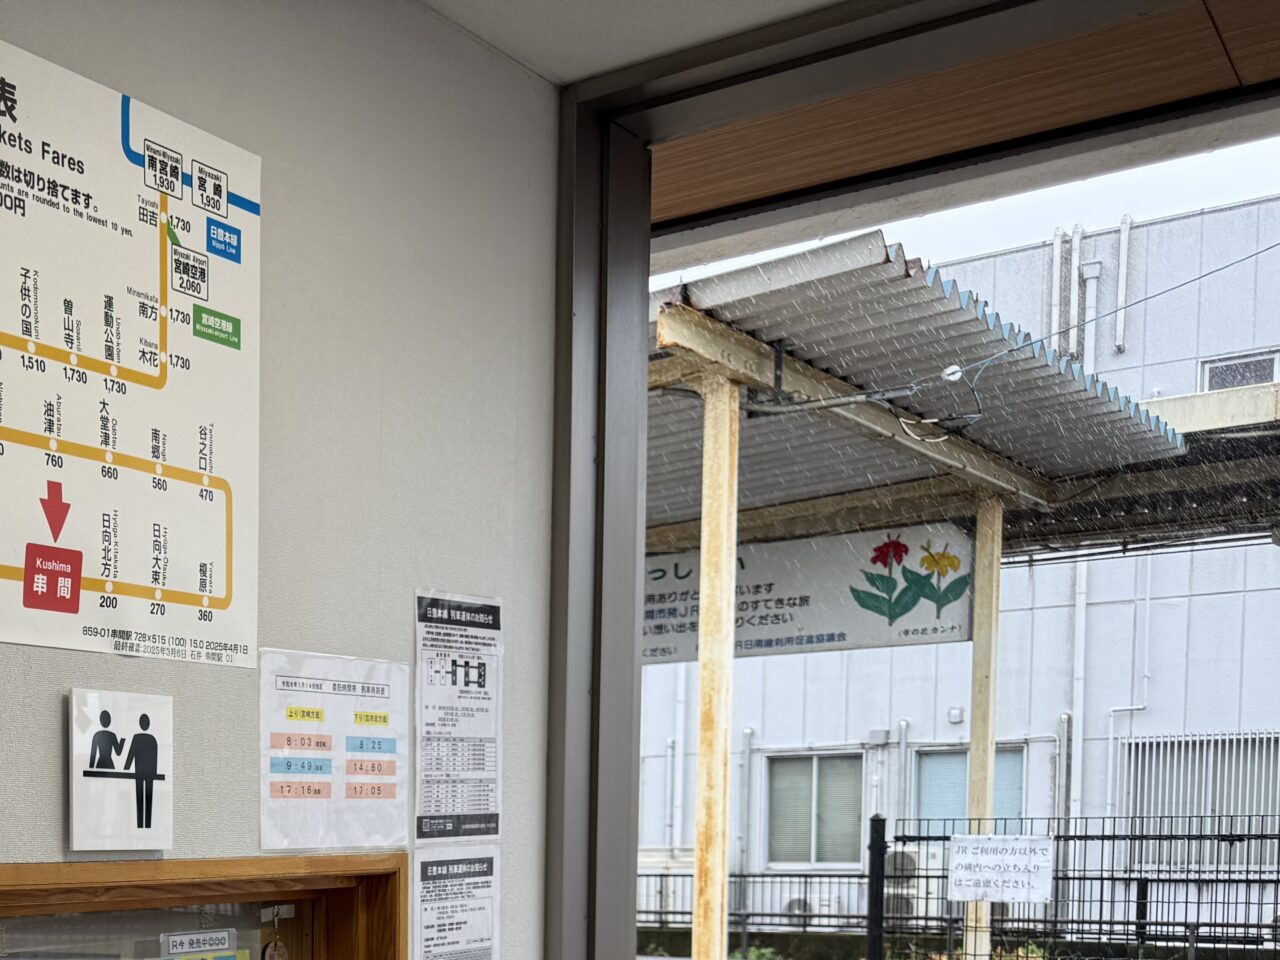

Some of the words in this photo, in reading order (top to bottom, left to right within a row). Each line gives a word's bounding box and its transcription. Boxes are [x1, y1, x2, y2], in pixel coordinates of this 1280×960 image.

[41, 141, 85, 175] Fares
[147, 154, 179, 182] 南宮崎
[152, 173, 176, 193] 1,930
[197, 166, 222, 184] Miyazaki
[197, 176, 223, 200] 宮崎
[17, 187, 29, 199] are
[32, 194, 60, 211] rounded
[73, 207, 84, 220] the
[86, 211, 108, 229] lowest
[137, 194, 159, 209] Tayoshi
[199, 192, 221, 212] 1,930
[138, 206, 159, 227] 田吉
[168, 214, 191, 235] 1,730
[210, 225, 238, 247] 日豊本線
[173, 258, 207, 283] 宮崎空港
[126, 285, 159, 305] Minamikata
[179, 275, 202, 295] 2,060
[20, 266, 32, 338] 子供の国
[138, 301, 158, 322] 南方
[168, 307, 191, 326] 1,730
[201, 313, 232, 333] 宮崎空港線
[75, 319, 83, 353] Sosanji
[104, 294, 115, 362] 運動公園
[139, 336, 159, 351] Kibana
[20, 355, 46, 374] 1,510
[138, 347, 159, 369] 木花
[168, 352, 191, 371] 1,730
[63, 366, 88, 385] 1,730
[103, 377, 127, 396] 1,730
[43, 400, 55, 436] 油津
[99, 398, 110, 448] 大堂津
[151, 428, 161, 461] 南郷
[198, 425, 208, 471] 谷之口
[44, 453, 63, 470] 760
[101, 465, 119, 481] 660
[152, 476, 168, 492] 560
[198, 487, 214, 502] 470
[100, 513, 112, 578] 日向北方
[151, 523, 162, 587] 日向大束
[35, 556, 72, 573] Kushima
[32, 573, 73, 599] 串間
[99, 595, 118, 610] 200
[150, 602, 166, 617] 270
[197, 609, 213, 622] 360
[167, 634, 187, 649] (100)
[205, 638, 249, 656] 2025年4月1日
